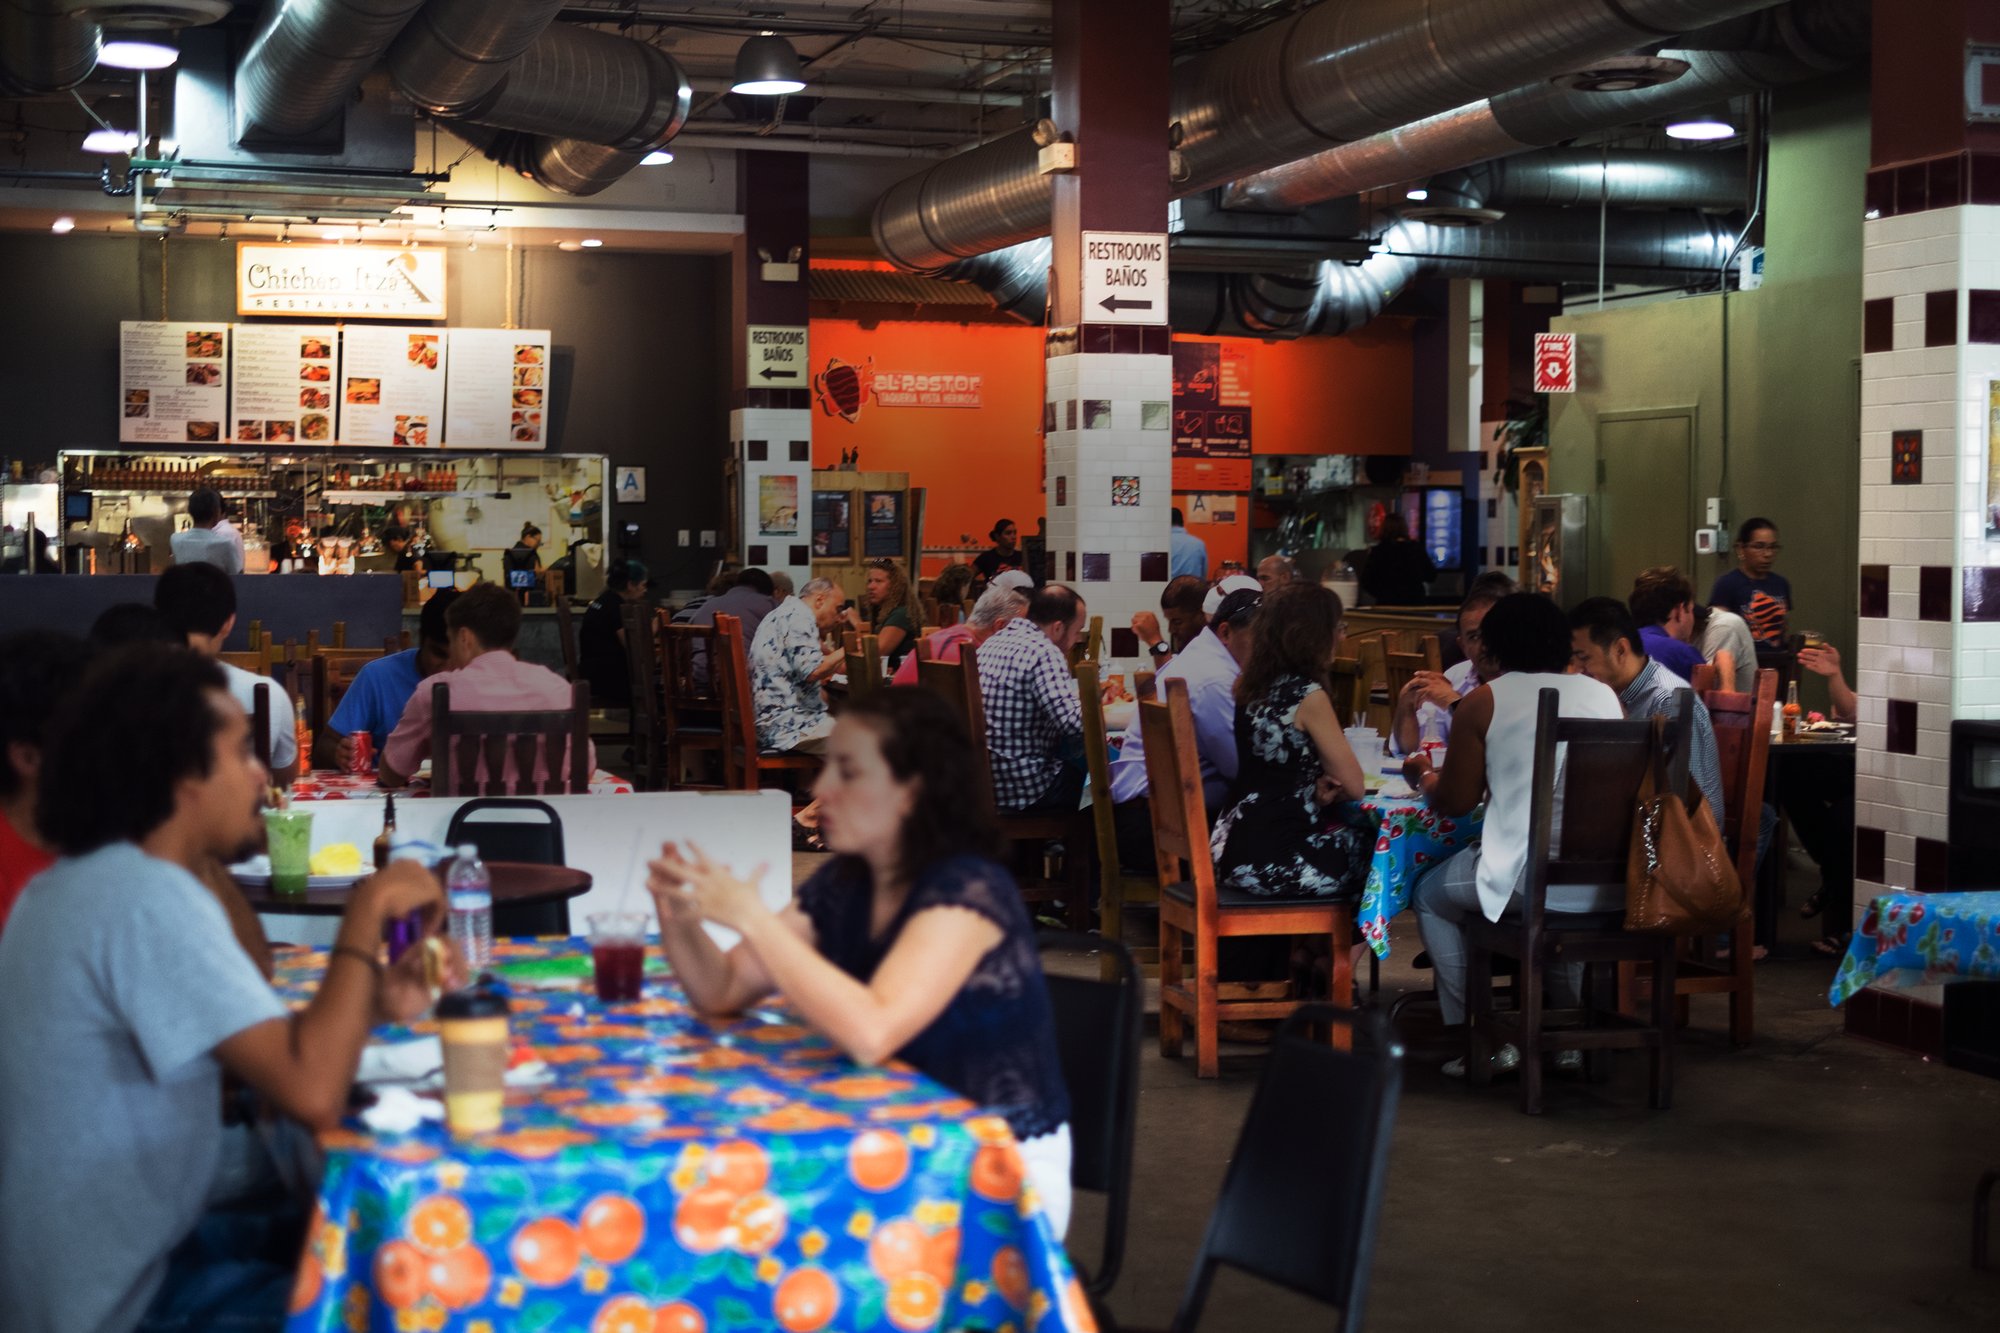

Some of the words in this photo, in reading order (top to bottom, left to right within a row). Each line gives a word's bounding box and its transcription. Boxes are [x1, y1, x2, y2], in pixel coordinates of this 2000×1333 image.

[1089, 241, 1161, 261] RESTROOMS
[1105, 264, 1147, 287] BAÑOS
[256, 299, 407, 310] RESTAURANT
[752, 331, 804, 345] RESTROOMS
[763, 346, 794, 361] BAÑOS
[623, 472, 639, 490] A
[1192, 494, 1207, 512] A
